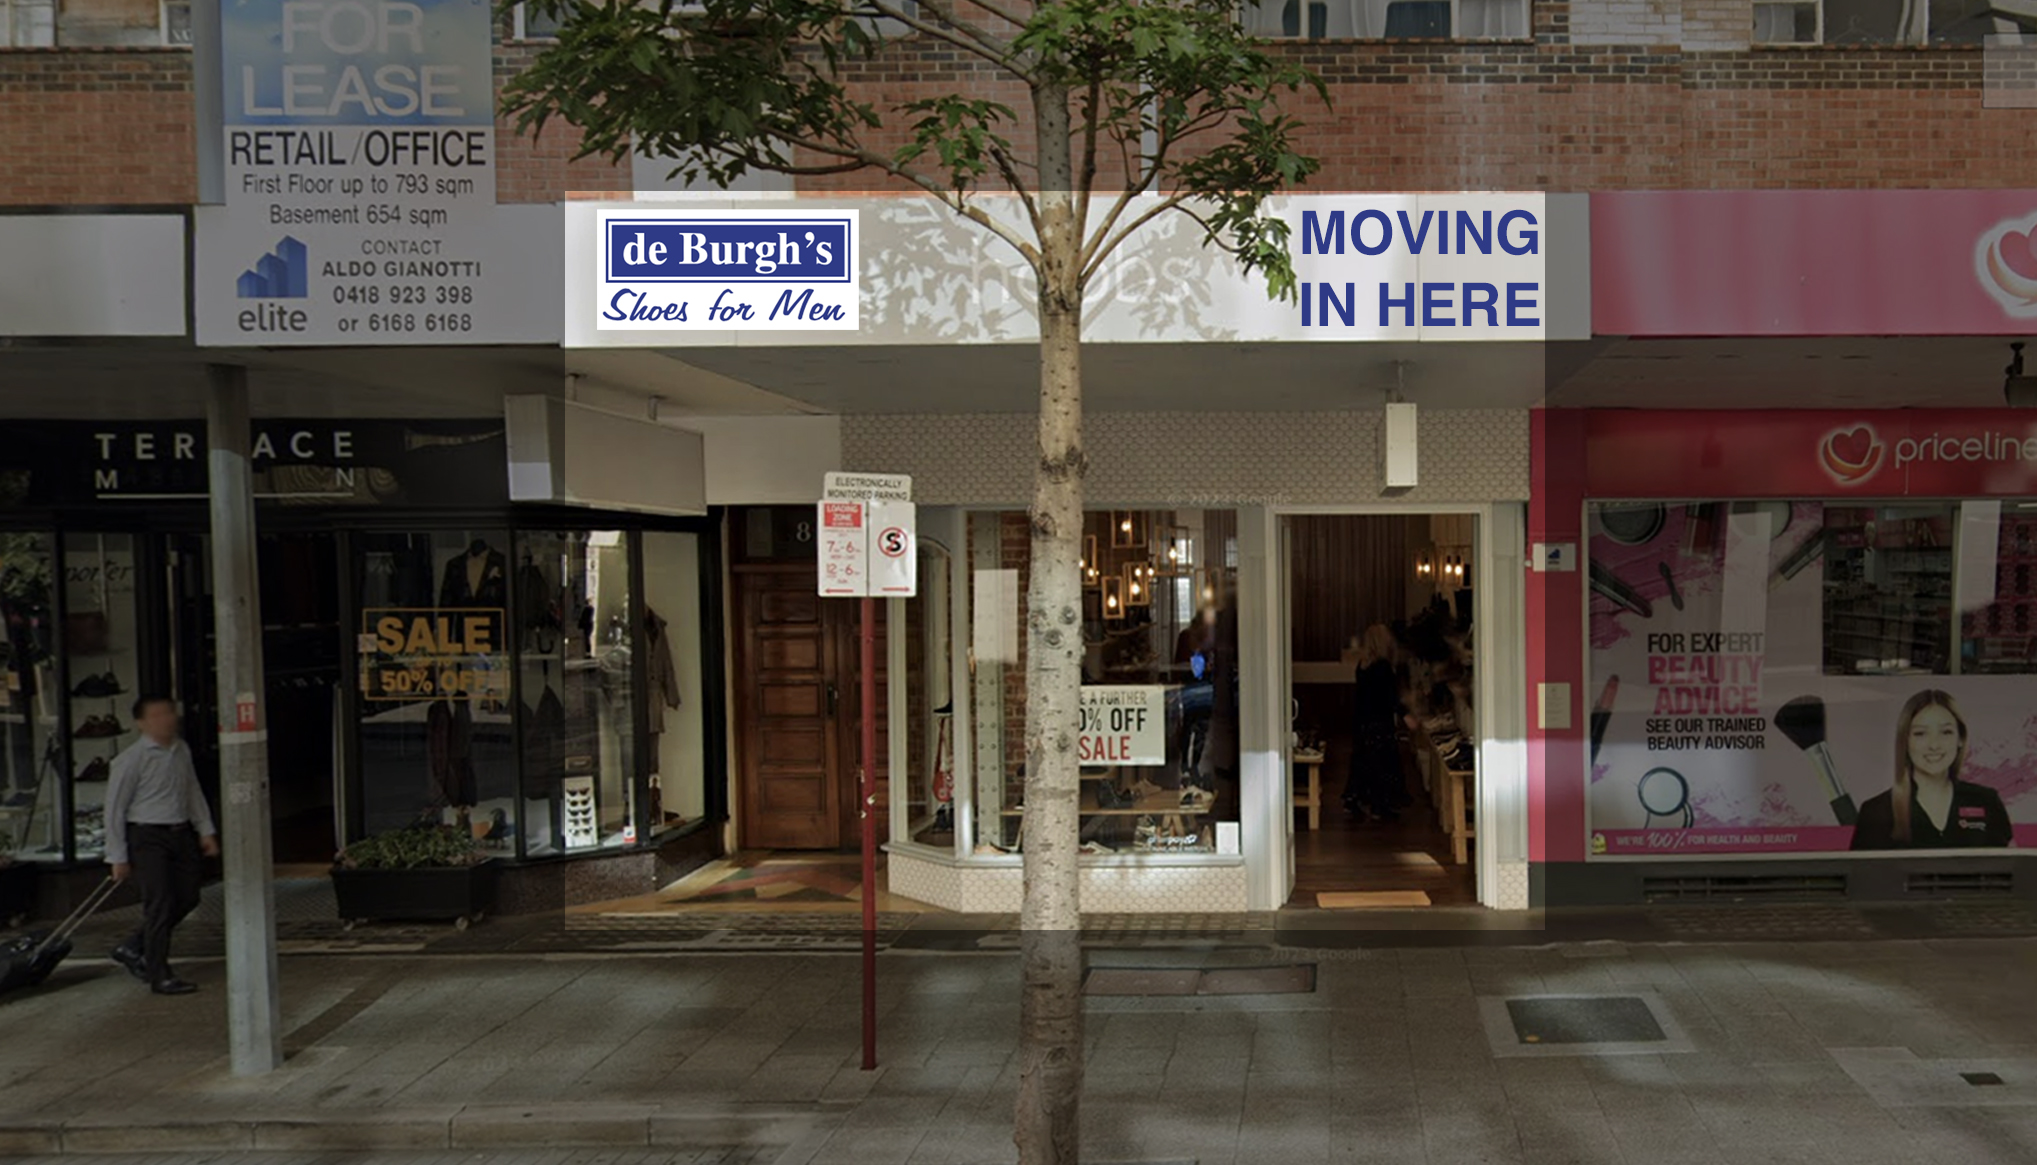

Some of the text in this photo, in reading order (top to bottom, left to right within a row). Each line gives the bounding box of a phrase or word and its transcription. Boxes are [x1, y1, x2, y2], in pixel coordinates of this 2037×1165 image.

[282, 2, 424, 54] FOR
[242, 64, 465, 116] LEASE
[243, 174, 474, 198] First Floor up to 793 sqm
[270, 204, 447, 228] Basement 654 sqm
[361, 239, 442, 255] CONTACT
[322, 261, 482, 277] ALDO GIANOTTI
[333, 285, 473, 304] 0418 923 398
[238, 303, 308, 332] elite
[338, 313, 473, 332] or 6168 6168
[95, 431, 354, 461] TERACE
[1895, 432, 2037, 469] priceline
[827, 489, 908, 501] MONITORED PARKING
[836, 478, 902, 488] ELECTRONICALLY
[377, 616, 492, 655] SALE
[1648, 632, 1764, 653] FOR EXPERT
[1648, 655, 1765, 684] BEAUTY
[381, 670, 489, 694] 50% OFF
[1089, 691, 1097, 705] A
[1100, 691, 1148, 705] FURTHER
[1654, 686, 1759, 715] ADVICE
[240, 704, 255, 723] H
[1111, 707, 1148, 731] OFF
[1646, 718, 1766, 733] SEE OUR TRAINED
[1080, 736, 1131, 760] SALE
[1648, 735, 1765, 750] BEAUTY ADVISOR
[1616, 831, 1798, 849] WE'RE 100% FOR HEALTH AND BEAUTY
